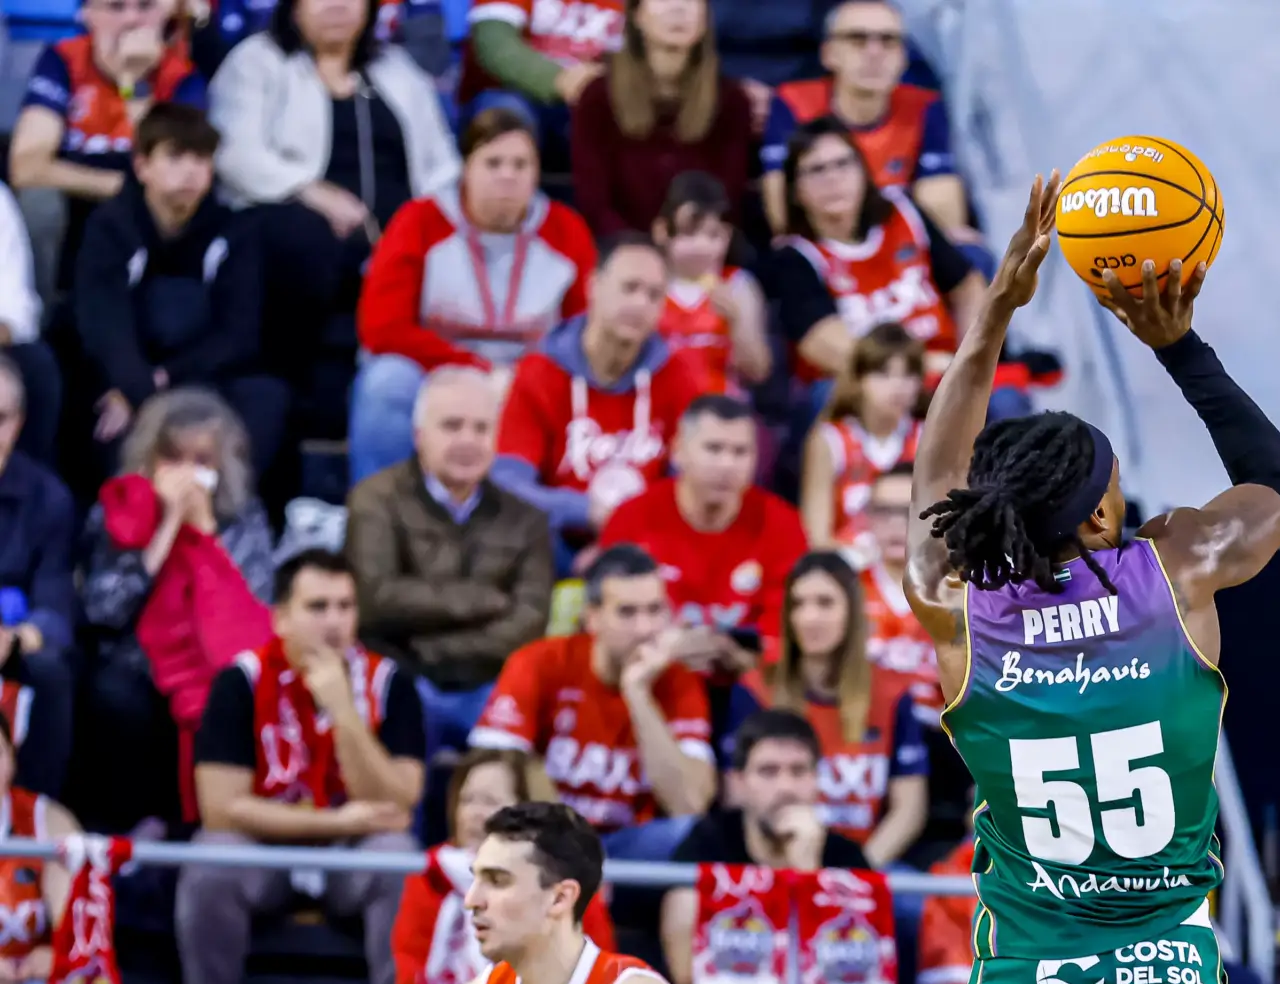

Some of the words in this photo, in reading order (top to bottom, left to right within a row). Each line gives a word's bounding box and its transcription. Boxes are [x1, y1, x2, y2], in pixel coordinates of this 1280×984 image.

[1061, 186, 1158, 218] Wilson
[1021, 595, 1120, 645] PERRY
[1009, 720, 1176, 866] 55
[1115, 939, 1203, 967] COSTA
